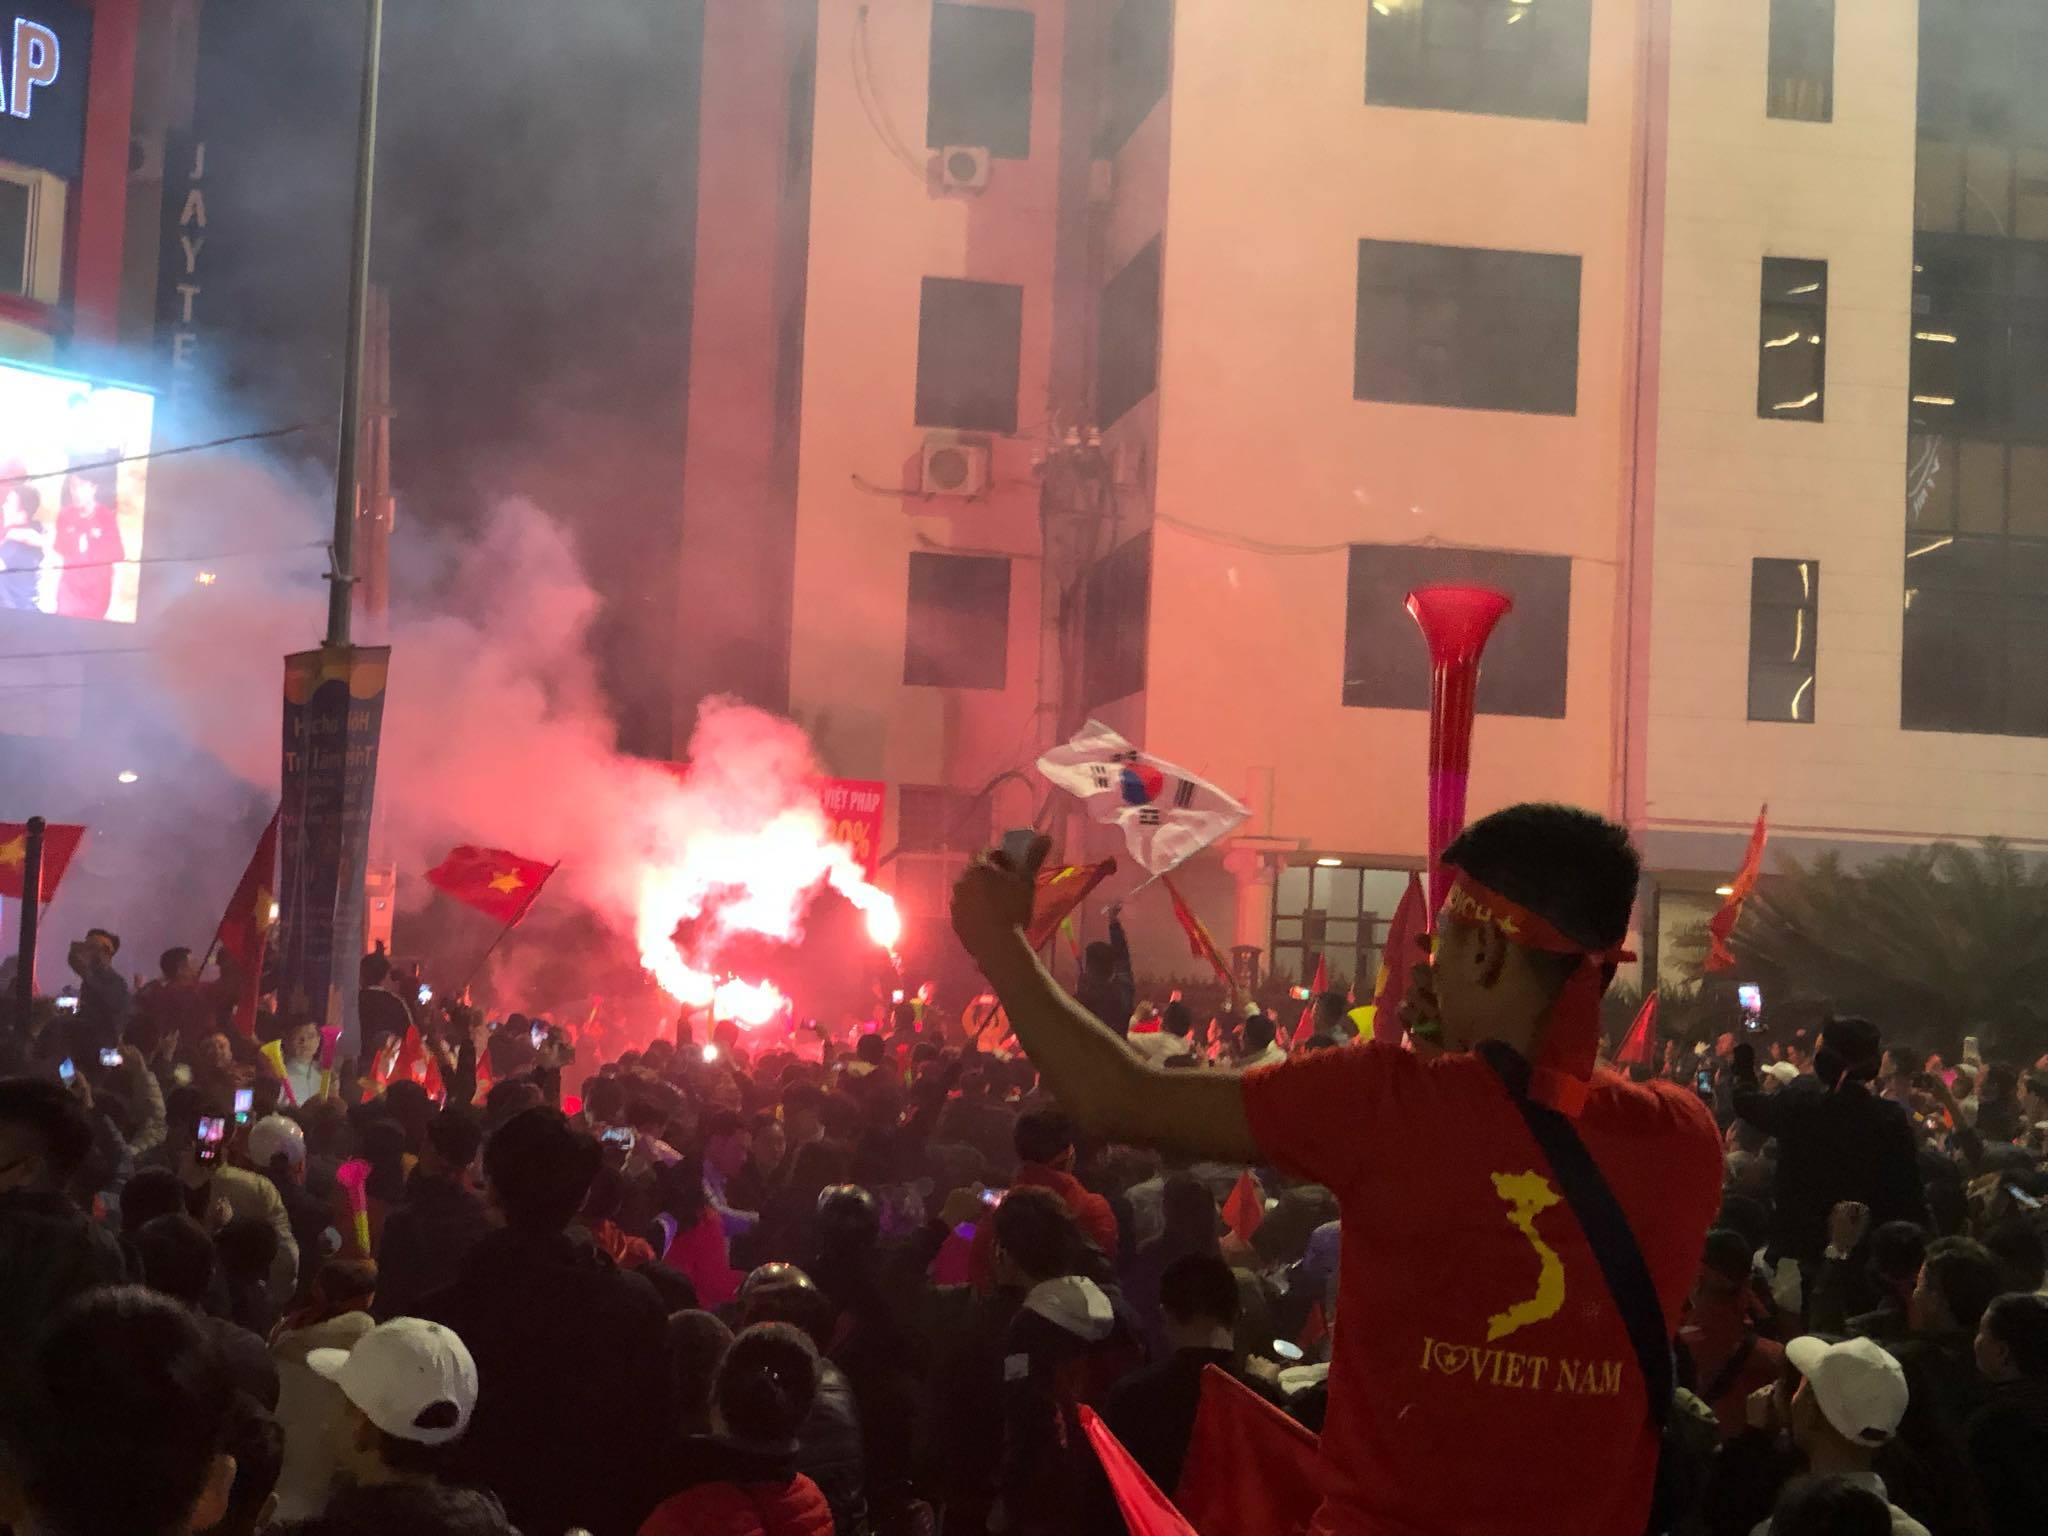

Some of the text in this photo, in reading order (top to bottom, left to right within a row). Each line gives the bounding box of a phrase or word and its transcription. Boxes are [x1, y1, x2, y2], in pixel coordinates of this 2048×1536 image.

[0, 17, 60, 119] P
[1420, 1336, 1624, 1395] I VIET NAM
